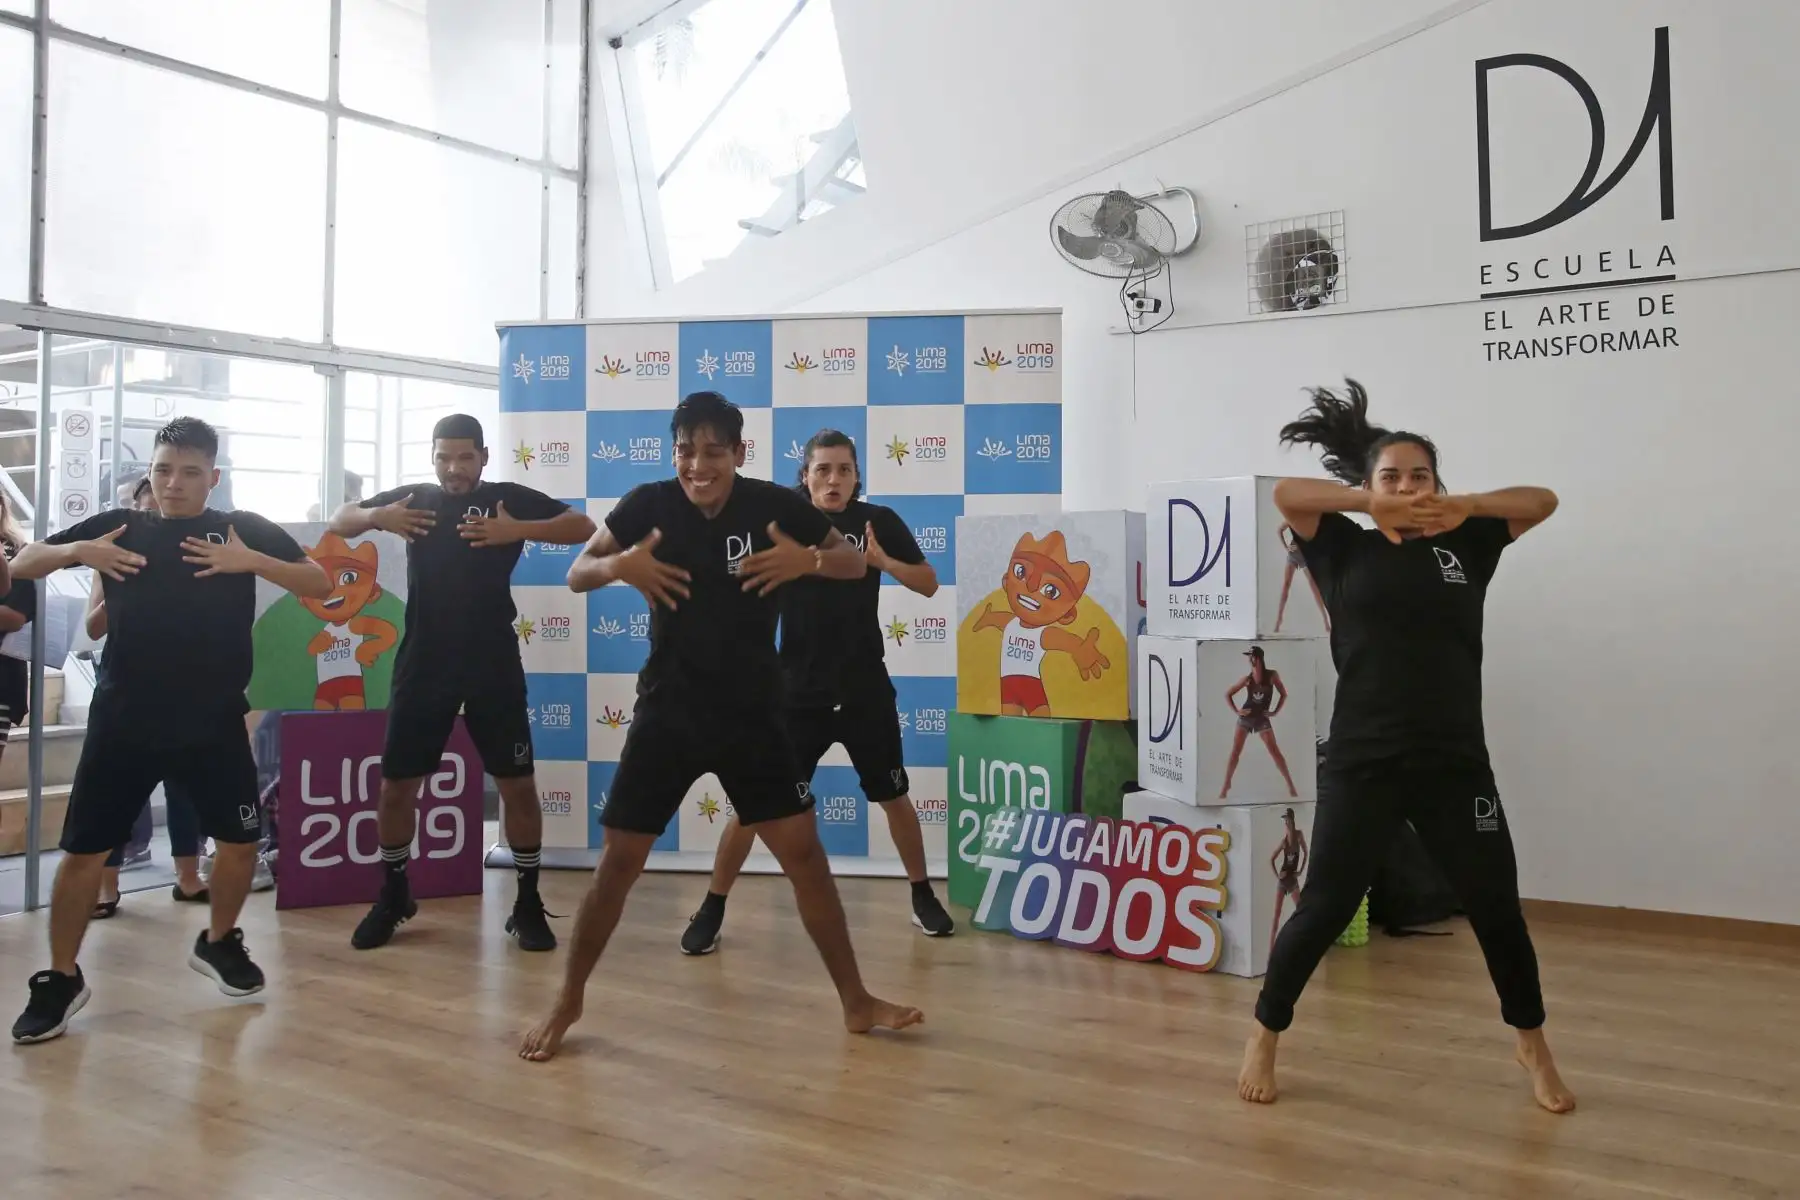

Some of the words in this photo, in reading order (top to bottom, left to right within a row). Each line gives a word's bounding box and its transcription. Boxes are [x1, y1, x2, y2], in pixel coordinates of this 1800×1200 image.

[1480, 245, 1676, 285] ESCUELA
[1484, 310, 1513, 331] EL
[1538, 300, 1611, 327] ARTE
[1638, 294, 1675, 317] DE
[1483, 326, 1680, 361] TRANSFORMAR
[823, 360, 856, 371] 2019
[916, 358, 946, 369] 2019
[1017, 355, 1054, 368] 2019
[540, 366, 570, 378] 2019
[636, 364, 670, 376] 2019
[725, 362, 755, 374] 2019
[540, 452, 570, 464] 2019
[630, 449, 662, 461] 2019
[915, 448, 946, 458] 2019
[1016, 446, 1050, 458] 2019
[915, 538, 946, 549] 2019
[1169, 594, 1179, 604] EL
[1186, 594, 1210, 605] ARTE
[1217, 595, 1230, 605] DE
[1169, 609, 1231, 620] TRANSFORMAR
[542, 627, 570, 638] 2019
[630, 625, 649, 636] 20
[914, 628, 946, 640] 2019
[324, 648, 350, 662] 2019
[1006, 646, 1034, 662] 2019
[542, 714, 571, 726] 2019
[916, 720, 946, 732] 2019
[1158, 752, 1172, 764] ARTE
[542, 802, 571, 812] 2019
[824, 808, 856, 820] 2019
[916, 810, 947, 822] 2019
[984, 810, 1225, 881] #JUGAMOS
[972, 855, 1222, 966] TODOS
